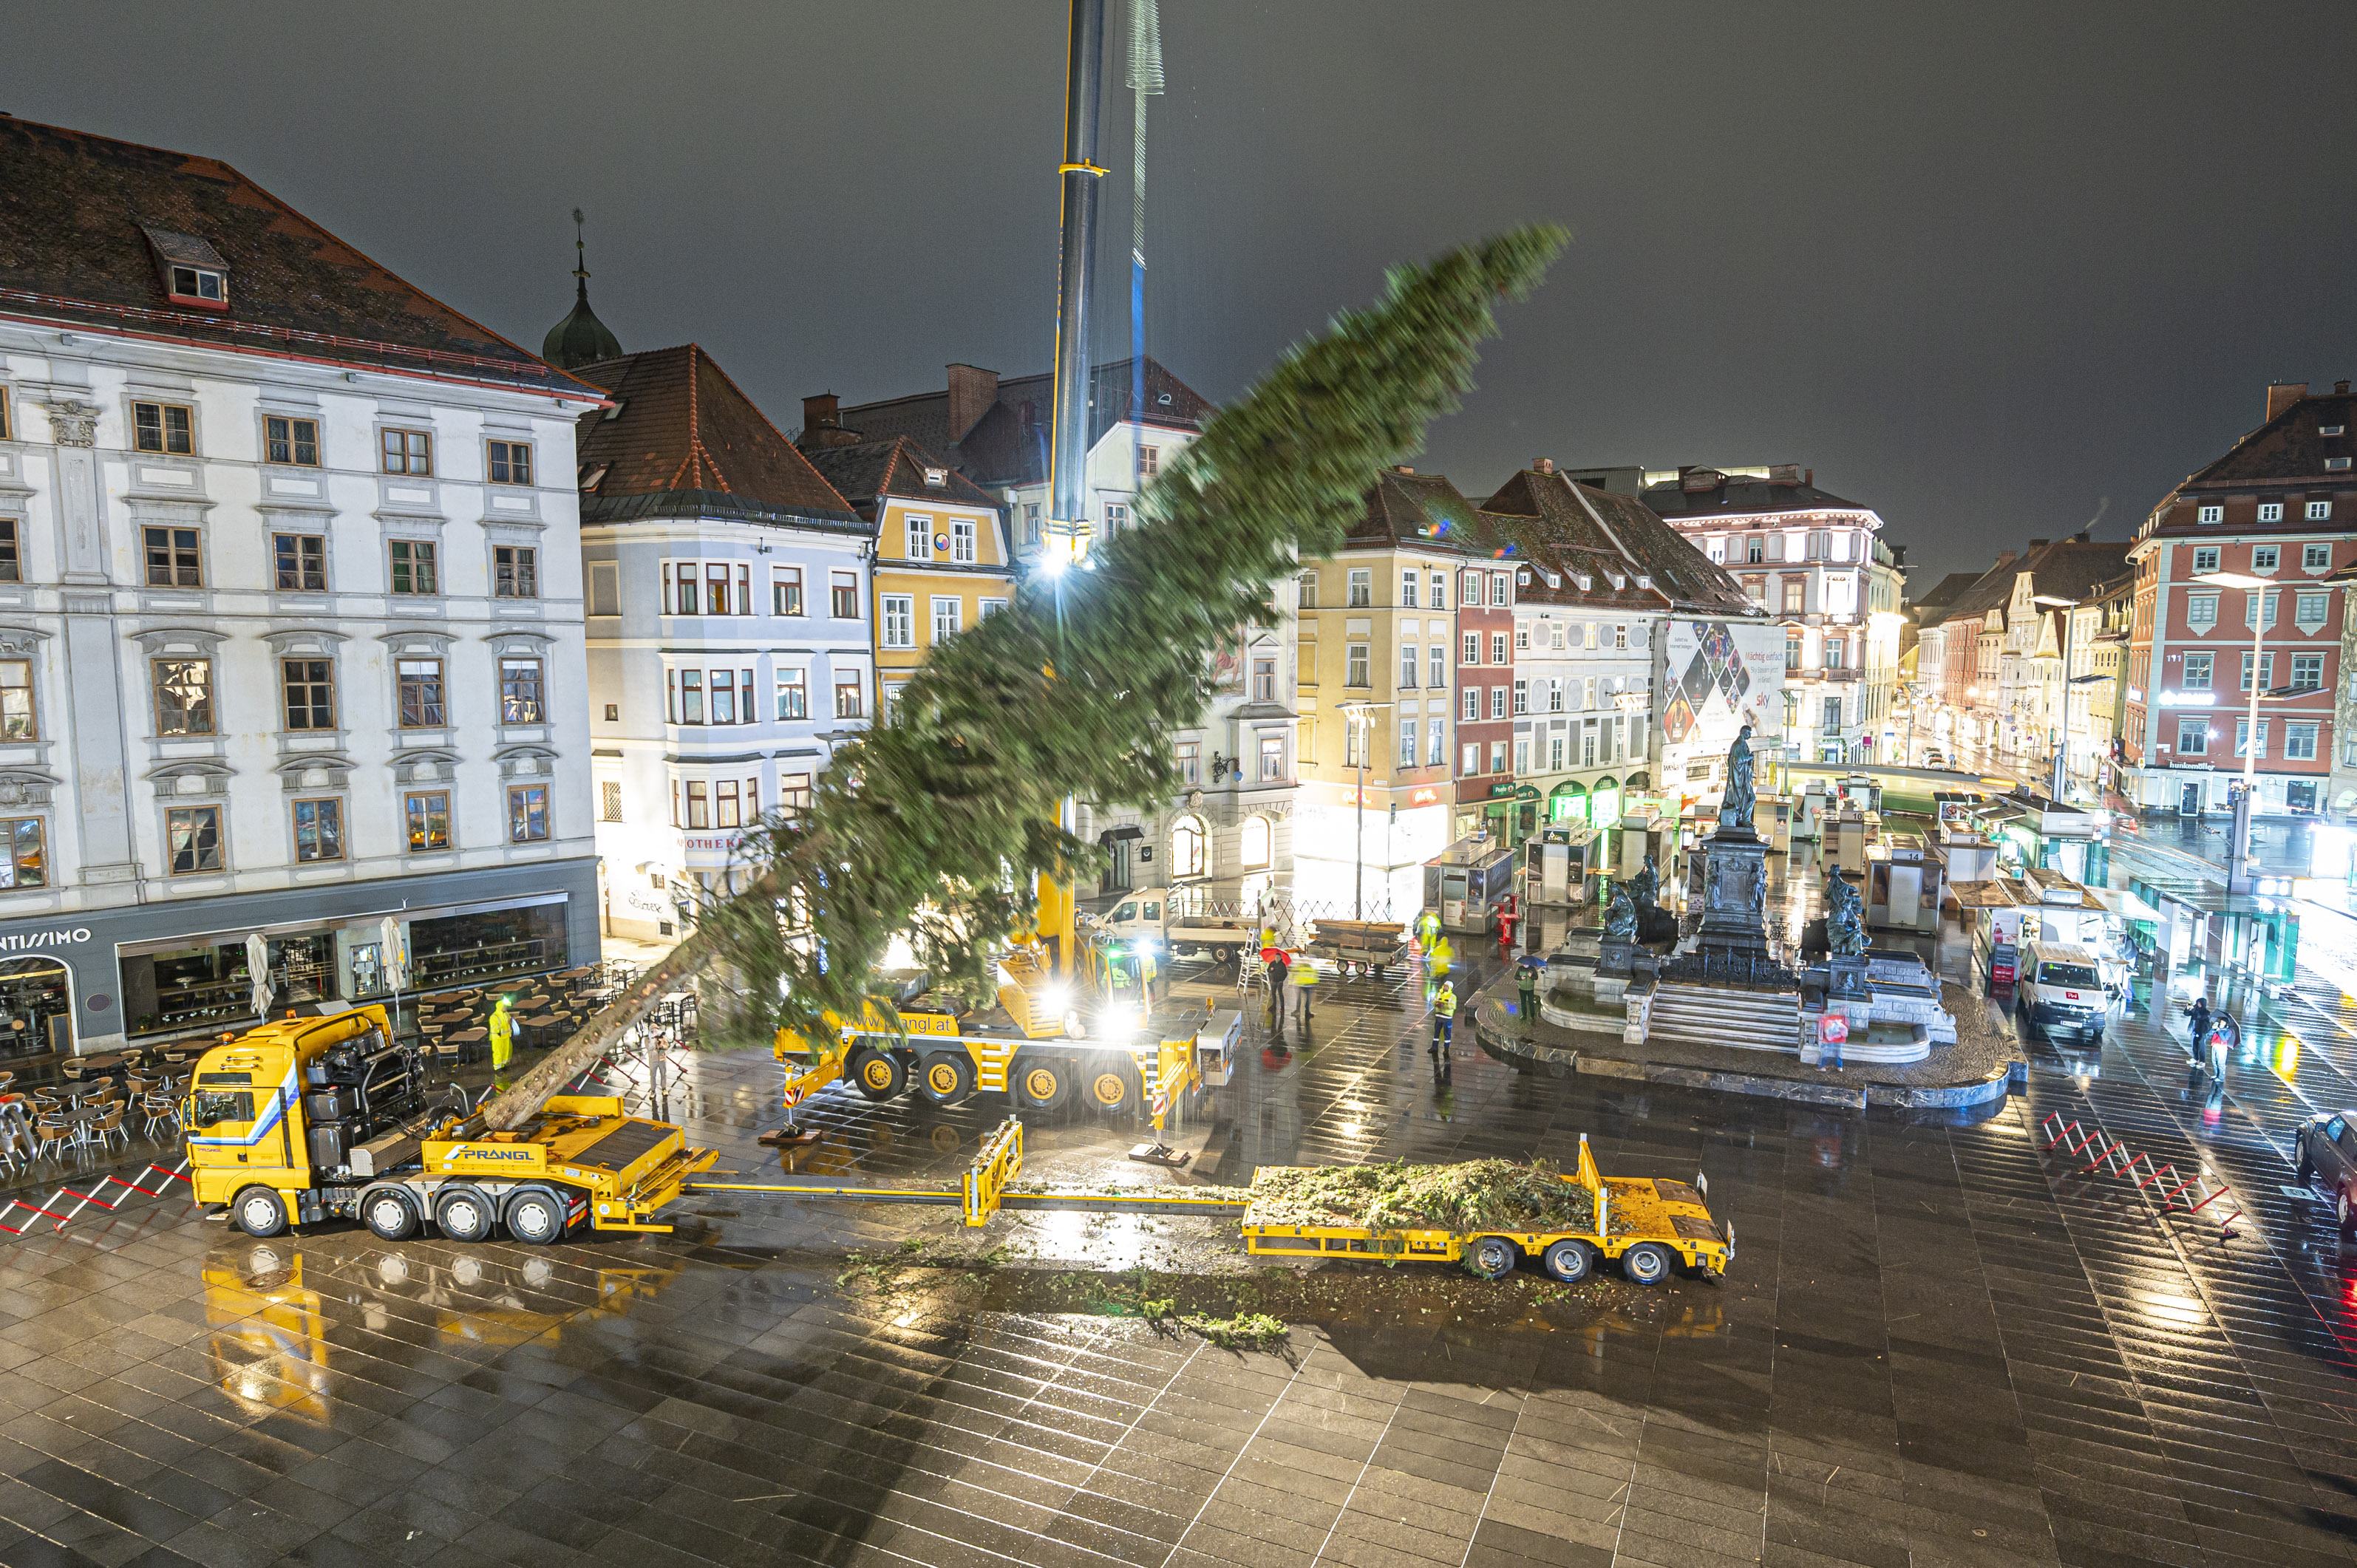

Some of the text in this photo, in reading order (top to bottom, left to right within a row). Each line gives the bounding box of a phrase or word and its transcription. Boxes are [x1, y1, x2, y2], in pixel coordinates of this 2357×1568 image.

[1745, 652, 1765, 664] Mächtig
[1756, 691, 1770, 709] sky
[2169, 760, 2216, 771] hunkemöller
[1908, 853, 1919, 862] 14
[0, 928, 92, 951] NTISSIMO
[844, 1017, 950, 1034] www.angl.at
[460, 1148, 535, 1161] PRANGL
